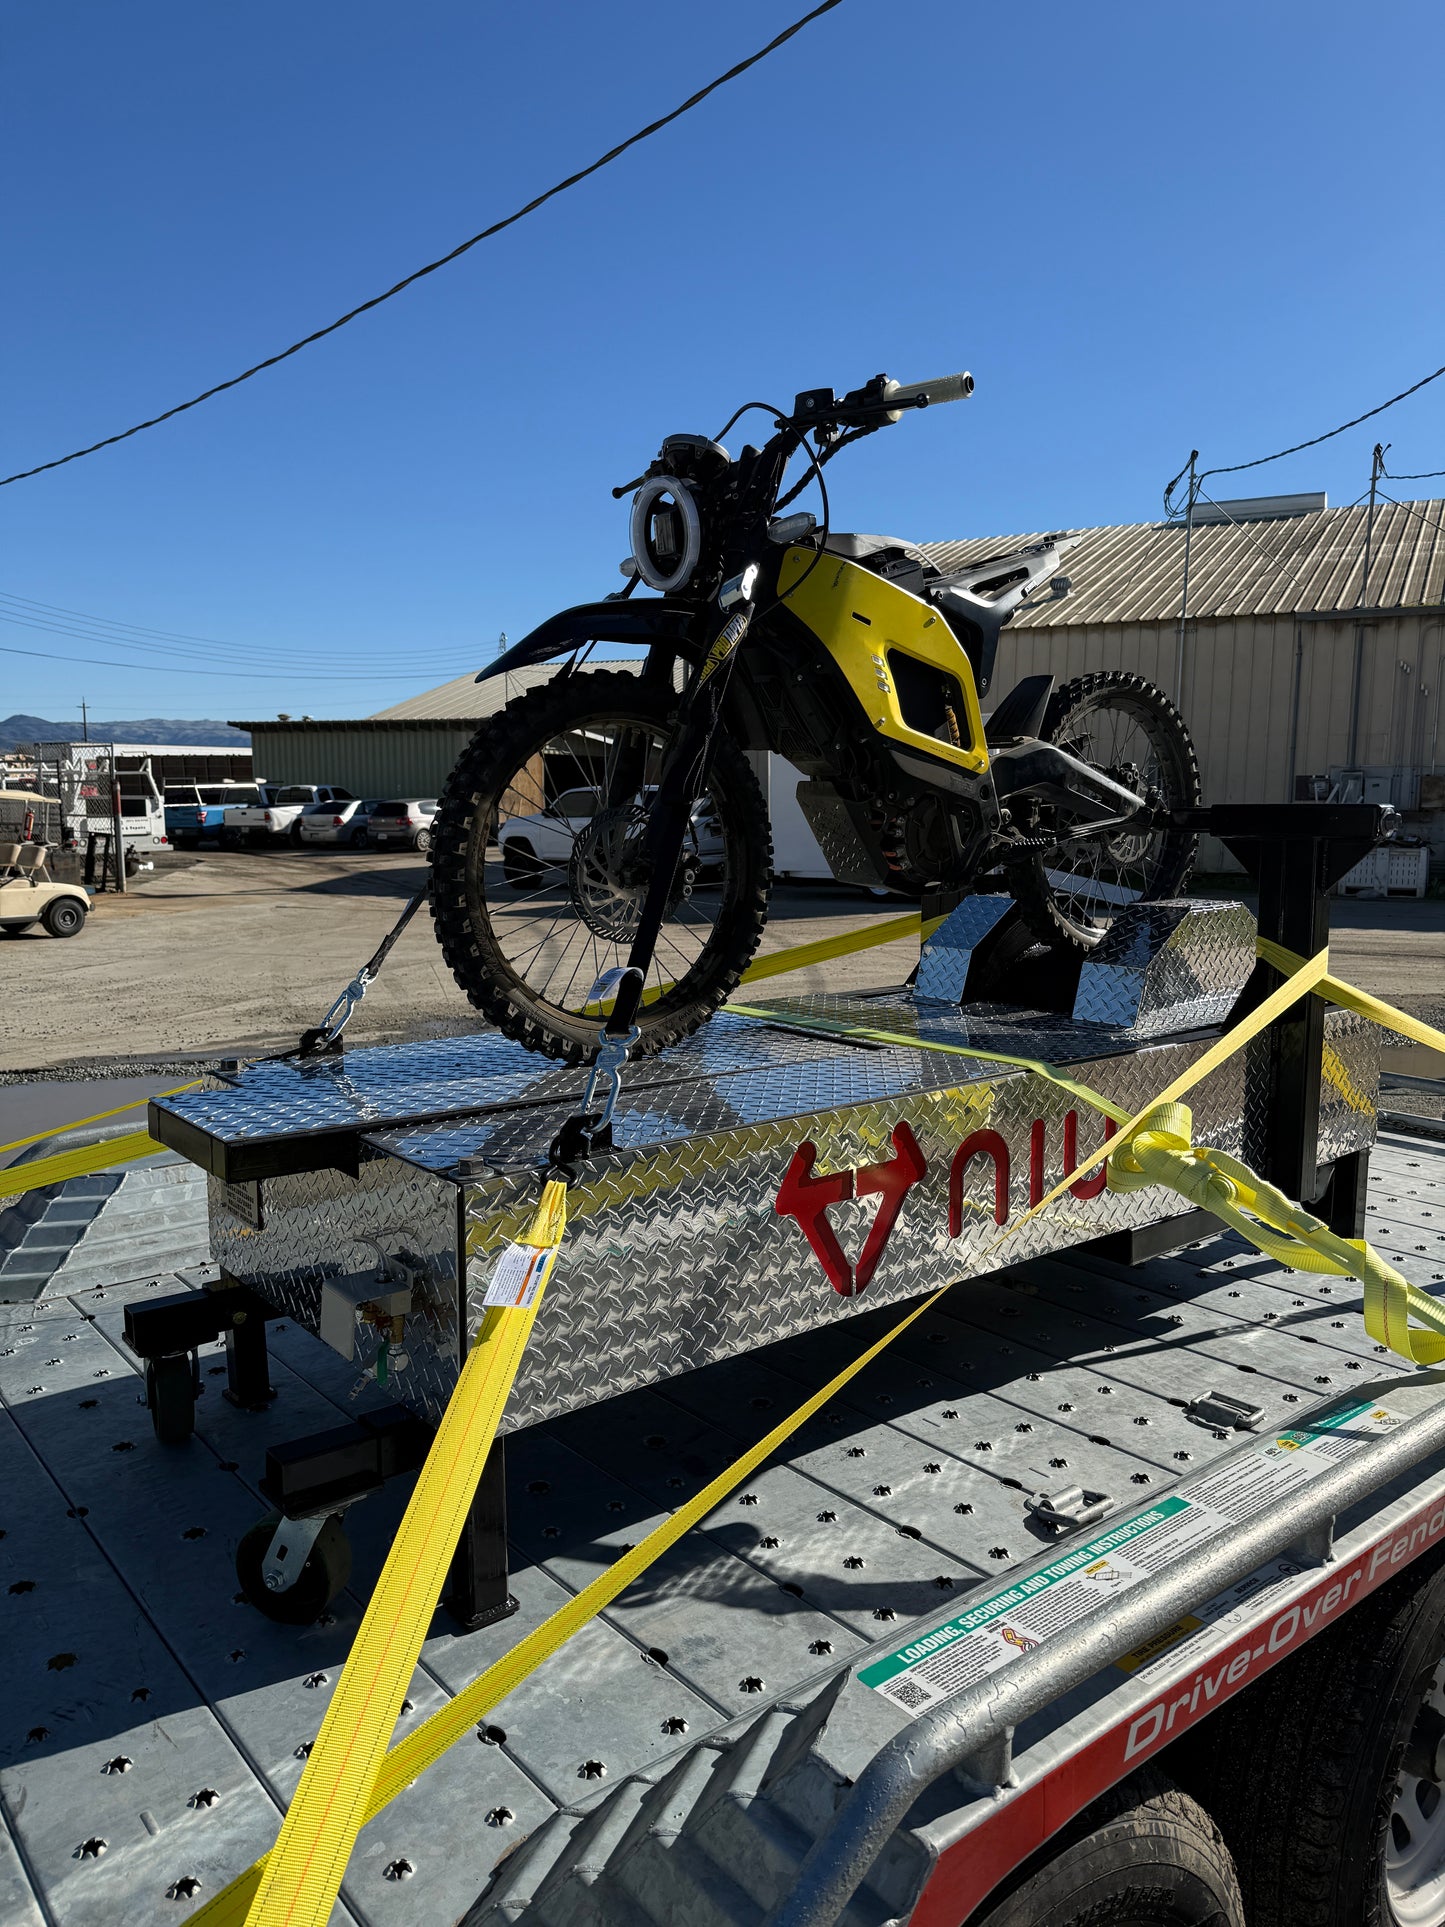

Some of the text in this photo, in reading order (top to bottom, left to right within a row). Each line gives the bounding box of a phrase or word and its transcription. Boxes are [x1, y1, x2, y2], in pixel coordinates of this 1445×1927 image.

[896, 1626, 966, 1664] LOADING,
[958, 1586, 1025, 1629] SECURING
[1019, 1575, 1049, 1595] AND
[1044, 1550, 1094, 1579] TOWING
[1091, 1510, 1165, 1554] INSTRUCTIONS
[1123, 1568, 1362, 1762] Drive-Over
